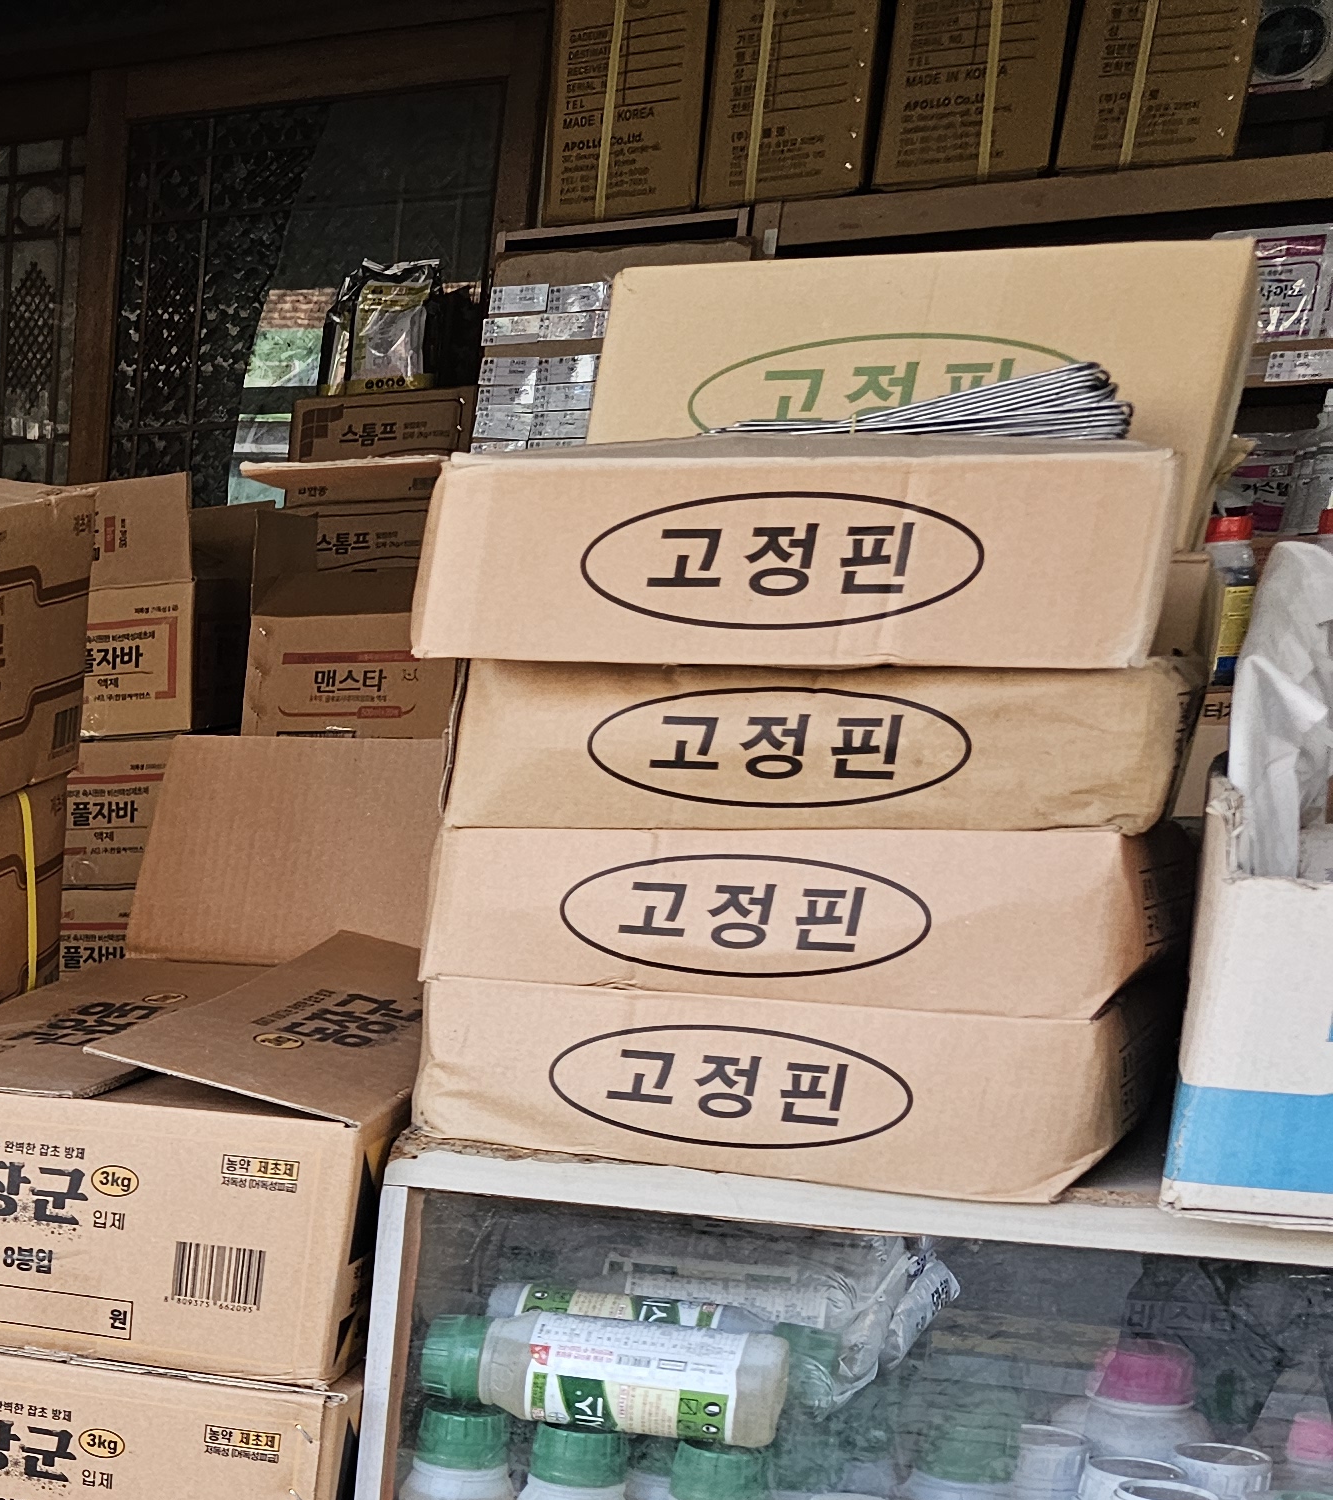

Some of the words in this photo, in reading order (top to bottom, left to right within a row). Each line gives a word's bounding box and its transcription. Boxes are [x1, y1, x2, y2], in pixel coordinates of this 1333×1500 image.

[563, 114, 595, 129] MADE
[617, 107, 655, 122] KOREA
[646, 521, 917, 597] 고정핀
[314, 668, 387, 692] 맨스타
[650, 710, 905, 781] 고정핀
[71, 802, 138, 826] 풀자바
[617, 878, 868, 953] 고정핀
[606, 1045, 853, 1128] 고정핀
[4, 1140, 36, 1156] 완벽한
[38, 1143, 61, 1159] 잡초
[64, 1145, 86, 1160] 방제
[226, 1156, 251, 1173] 농약
[256, 1159, 296, 1179] 제초제
[98, 1169, 131, 1193] 3kg
[92, 1210, 125, 1231] 입제
[109, 1307, 129, 1330] 원
